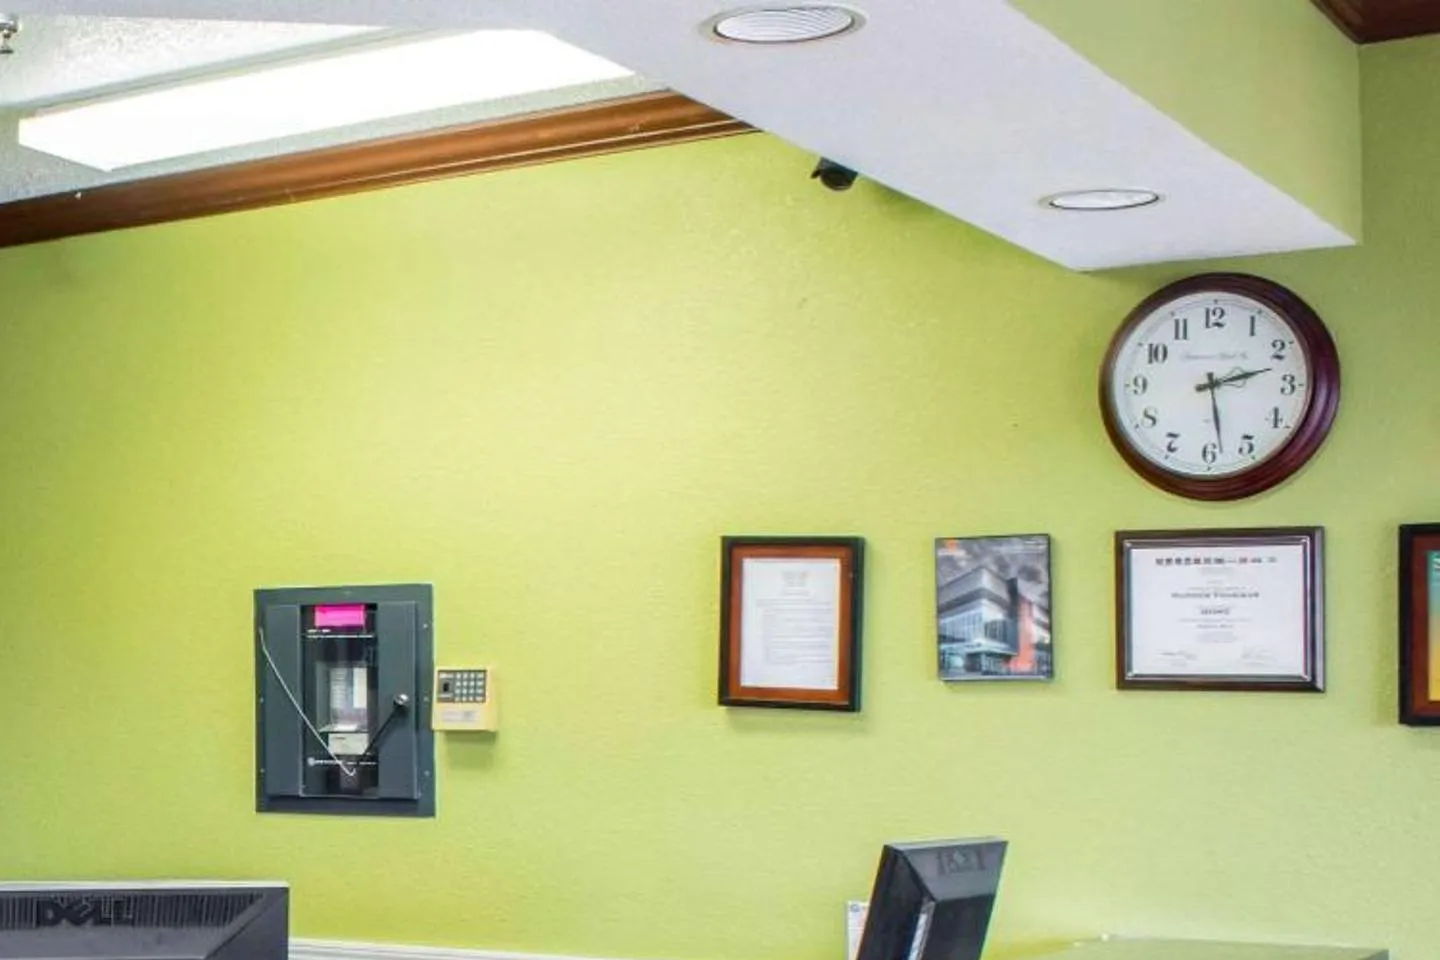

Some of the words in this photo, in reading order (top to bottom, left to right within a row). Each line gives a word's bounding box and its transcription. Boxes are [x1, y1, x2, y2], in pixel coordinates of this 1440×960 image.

[1204, 306, 1226, 329] 12
[1247, 315, 1257, 337] 1
[1173, 318, 1189, 341] 11
[1147, 343, 1168, 364] 10
[1270, 339, 1287, 360] 2
[1132, 375, 1148, 395] 9
[1280, 374, 1296, 396] 3
[1141, 406, 1158, 427] 8
[1265, 406, 1284, 429] 4
[1165, 432, 1181, 453] 7
[1201, 442, 1217, 464] 6
[1238, 434, 1255, 455] 5
